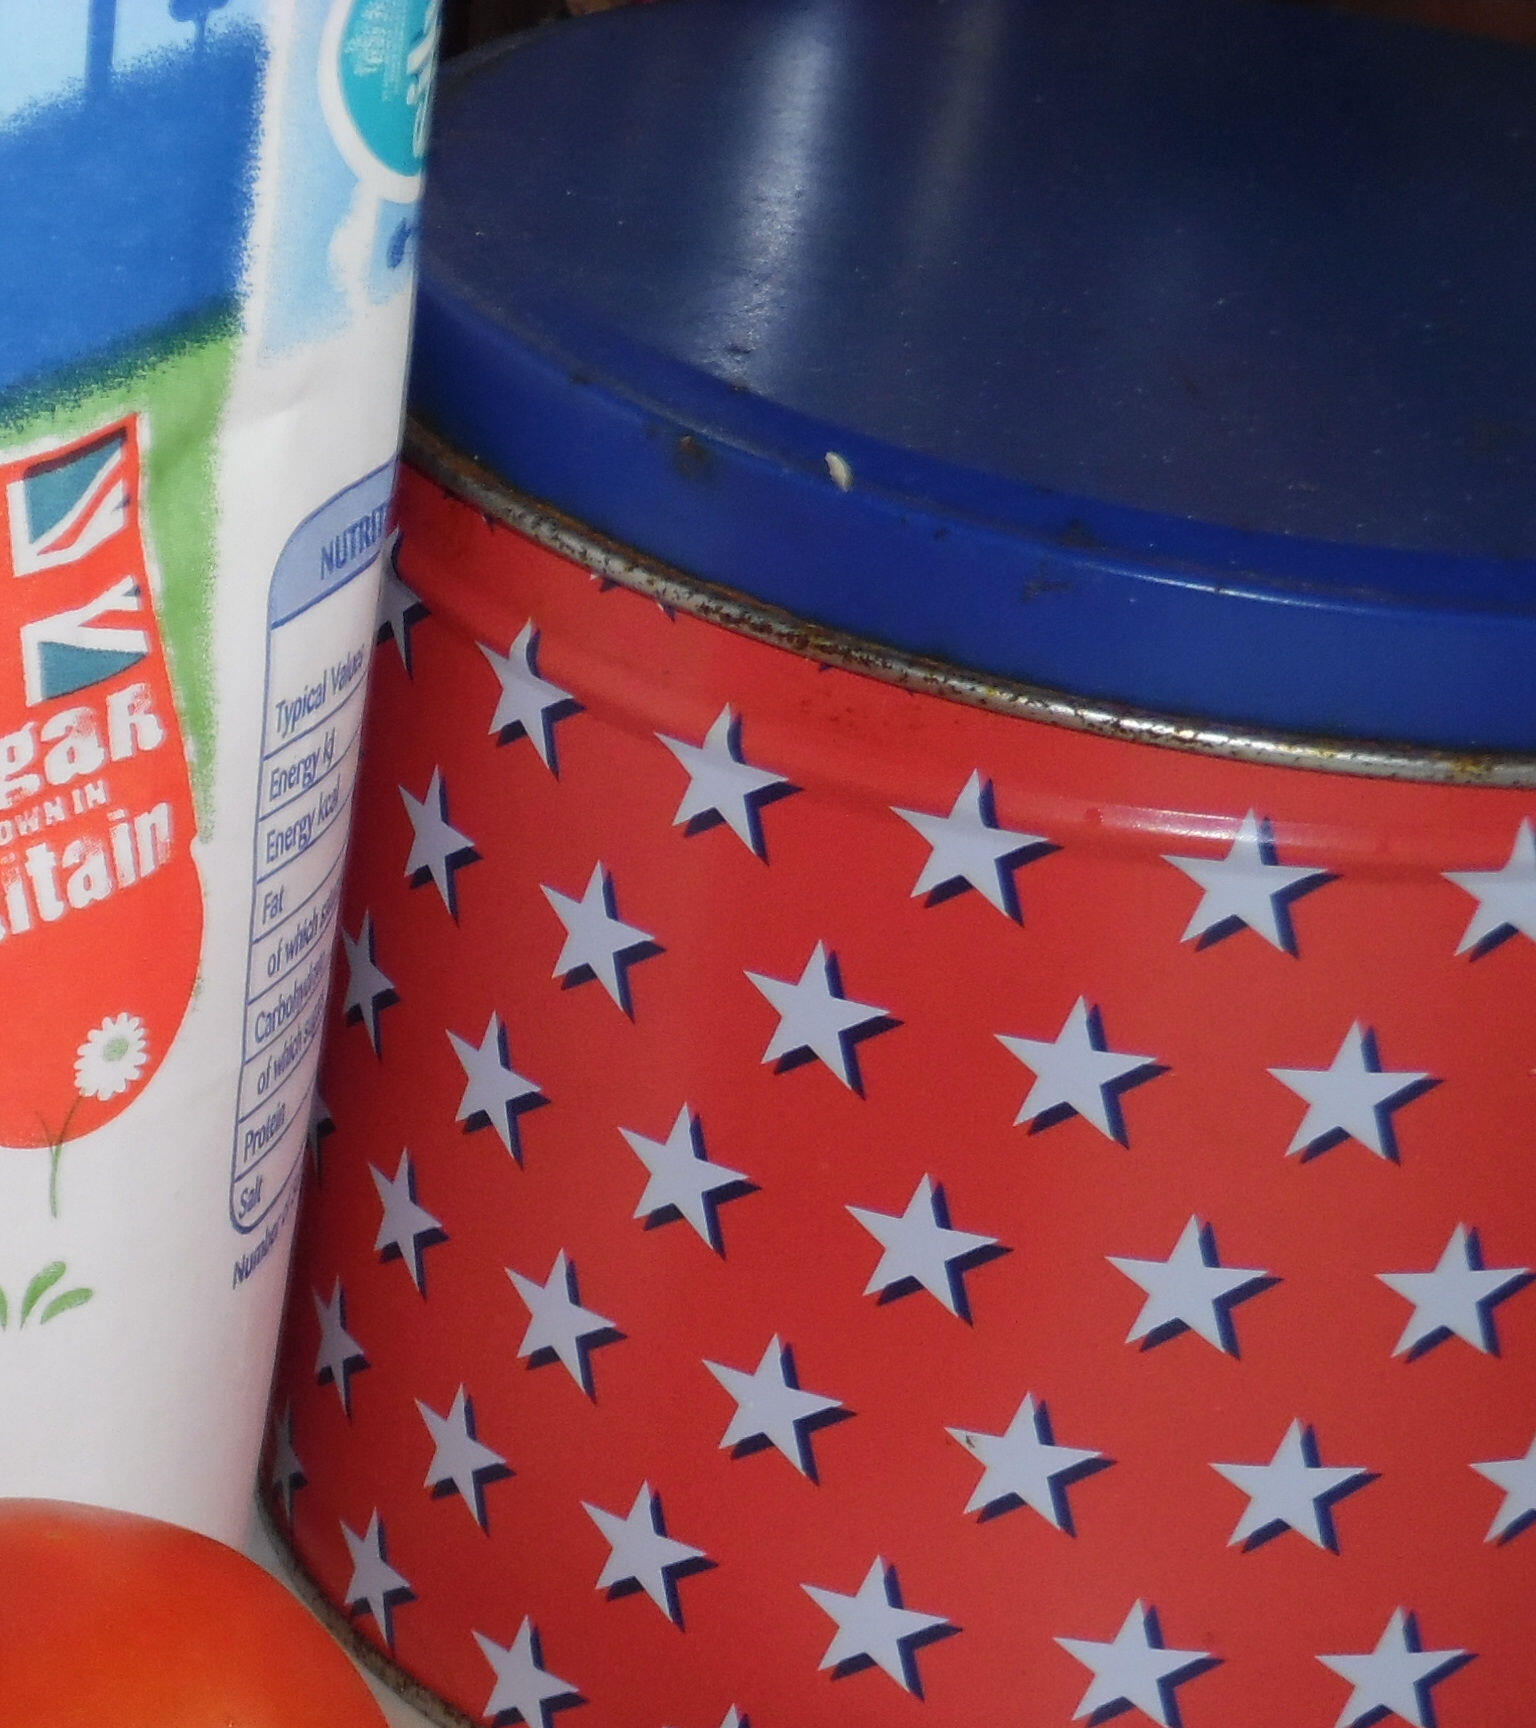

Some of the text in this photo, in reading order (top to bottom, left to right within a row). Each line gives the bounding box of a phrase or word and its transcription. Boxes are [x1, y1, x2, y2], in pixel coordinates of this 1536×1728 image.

[276, 668, 328, 738] Typical
[71, 779, 109, 815] IN
[269, 746, 321, 803] Energy
[265, 773, 341, 865] Energy kcal
[262, 884, 285, 925] Fat
[267, 937, 283, 978] of
[256, 1054, 272, 1096] of
[244, 1104, 286, 1163] Protein
[238, 1174, 263, 1219] Salt
